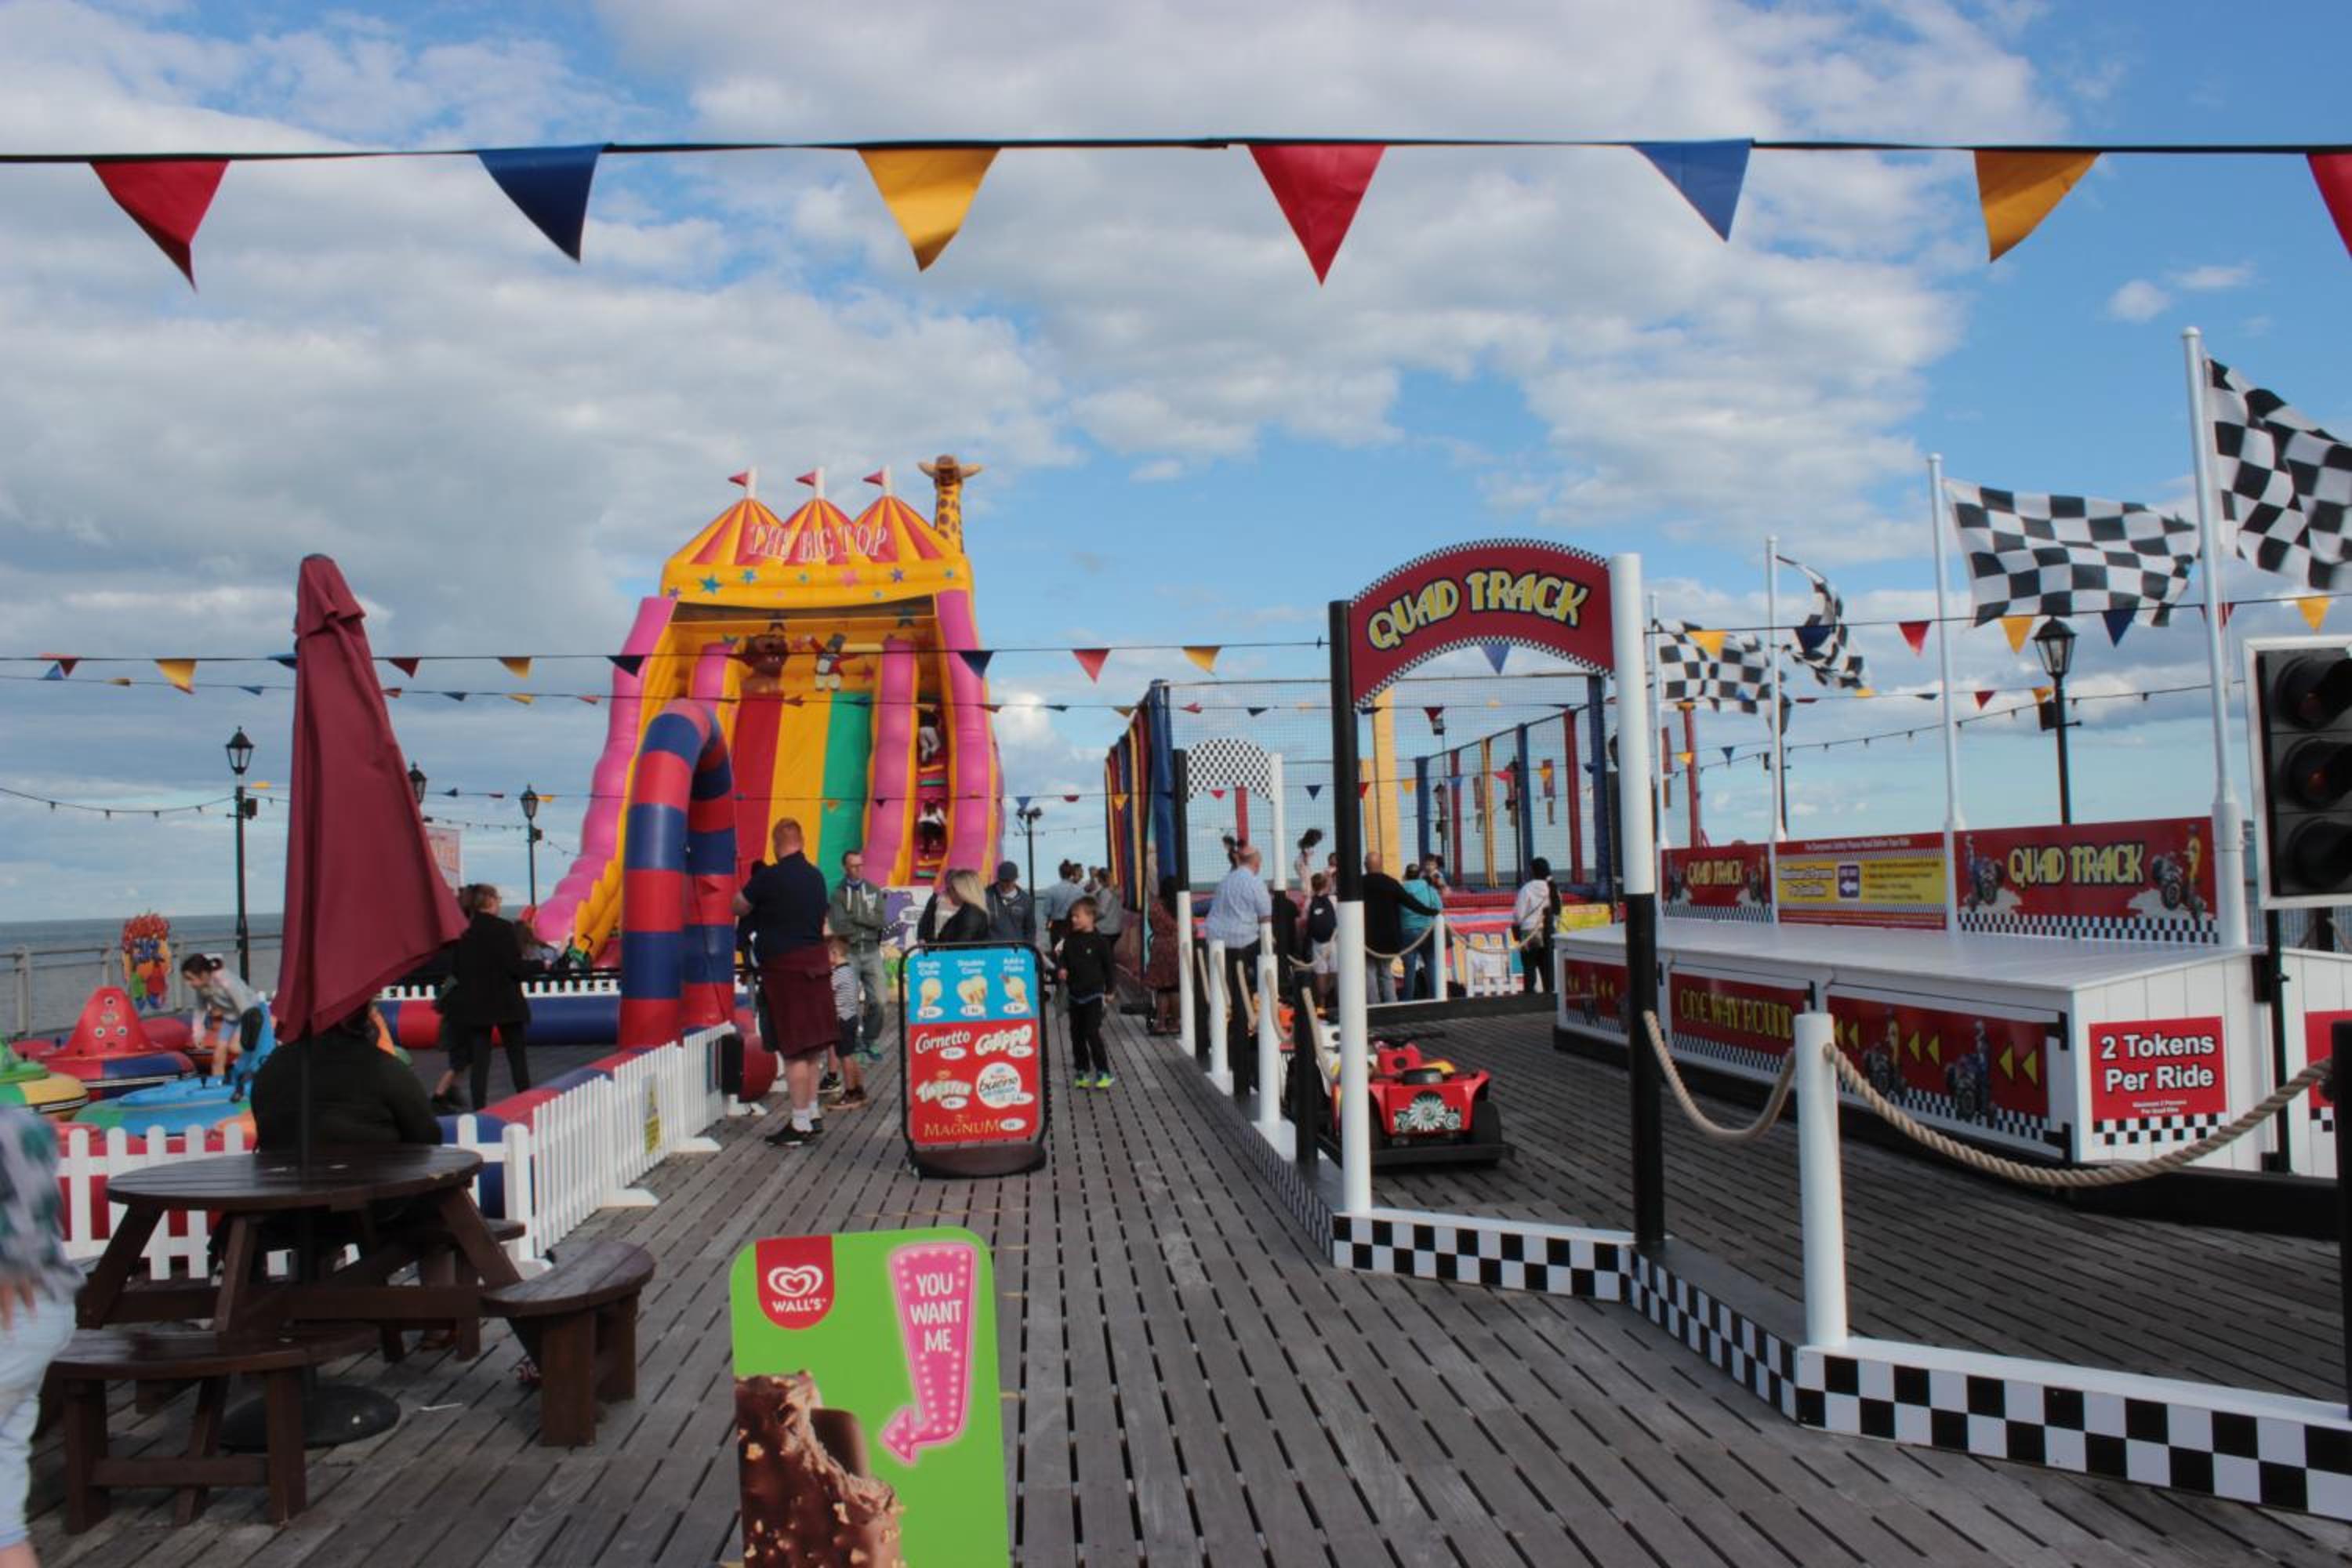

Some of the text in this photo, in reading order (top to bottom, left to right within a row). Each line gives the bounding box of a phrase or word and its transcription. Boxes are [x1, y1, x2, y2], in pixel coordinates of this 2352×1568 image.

[797, 528, 835, 564] BIG
[837, 524, 887, 556] TOP
[1367, 570, 1589, 650] QUAD TRACK
[1686, 860, 1712, 887] QUAD
[2008, 843, 2145, 888] QUAD TRACK
[1709, 993, 1740, 1030] WAY
[915, 1030, 971, 1054] Cornetto
[2100, 1033, 2216, 1059] 2 Tokens
[980, 1076, 1018, 1092] bueno
[2105, 1064, 2215, 1093] Per Ride
[924, 1118, 1000, 1138] MAGNUM
[916, 1272, 953, 1298] YOU
[771, 1298, 823, 1314] WALL'S
[909, 1300, 963, 1327] WANT
[924, 1329, 953, 1352] ME
